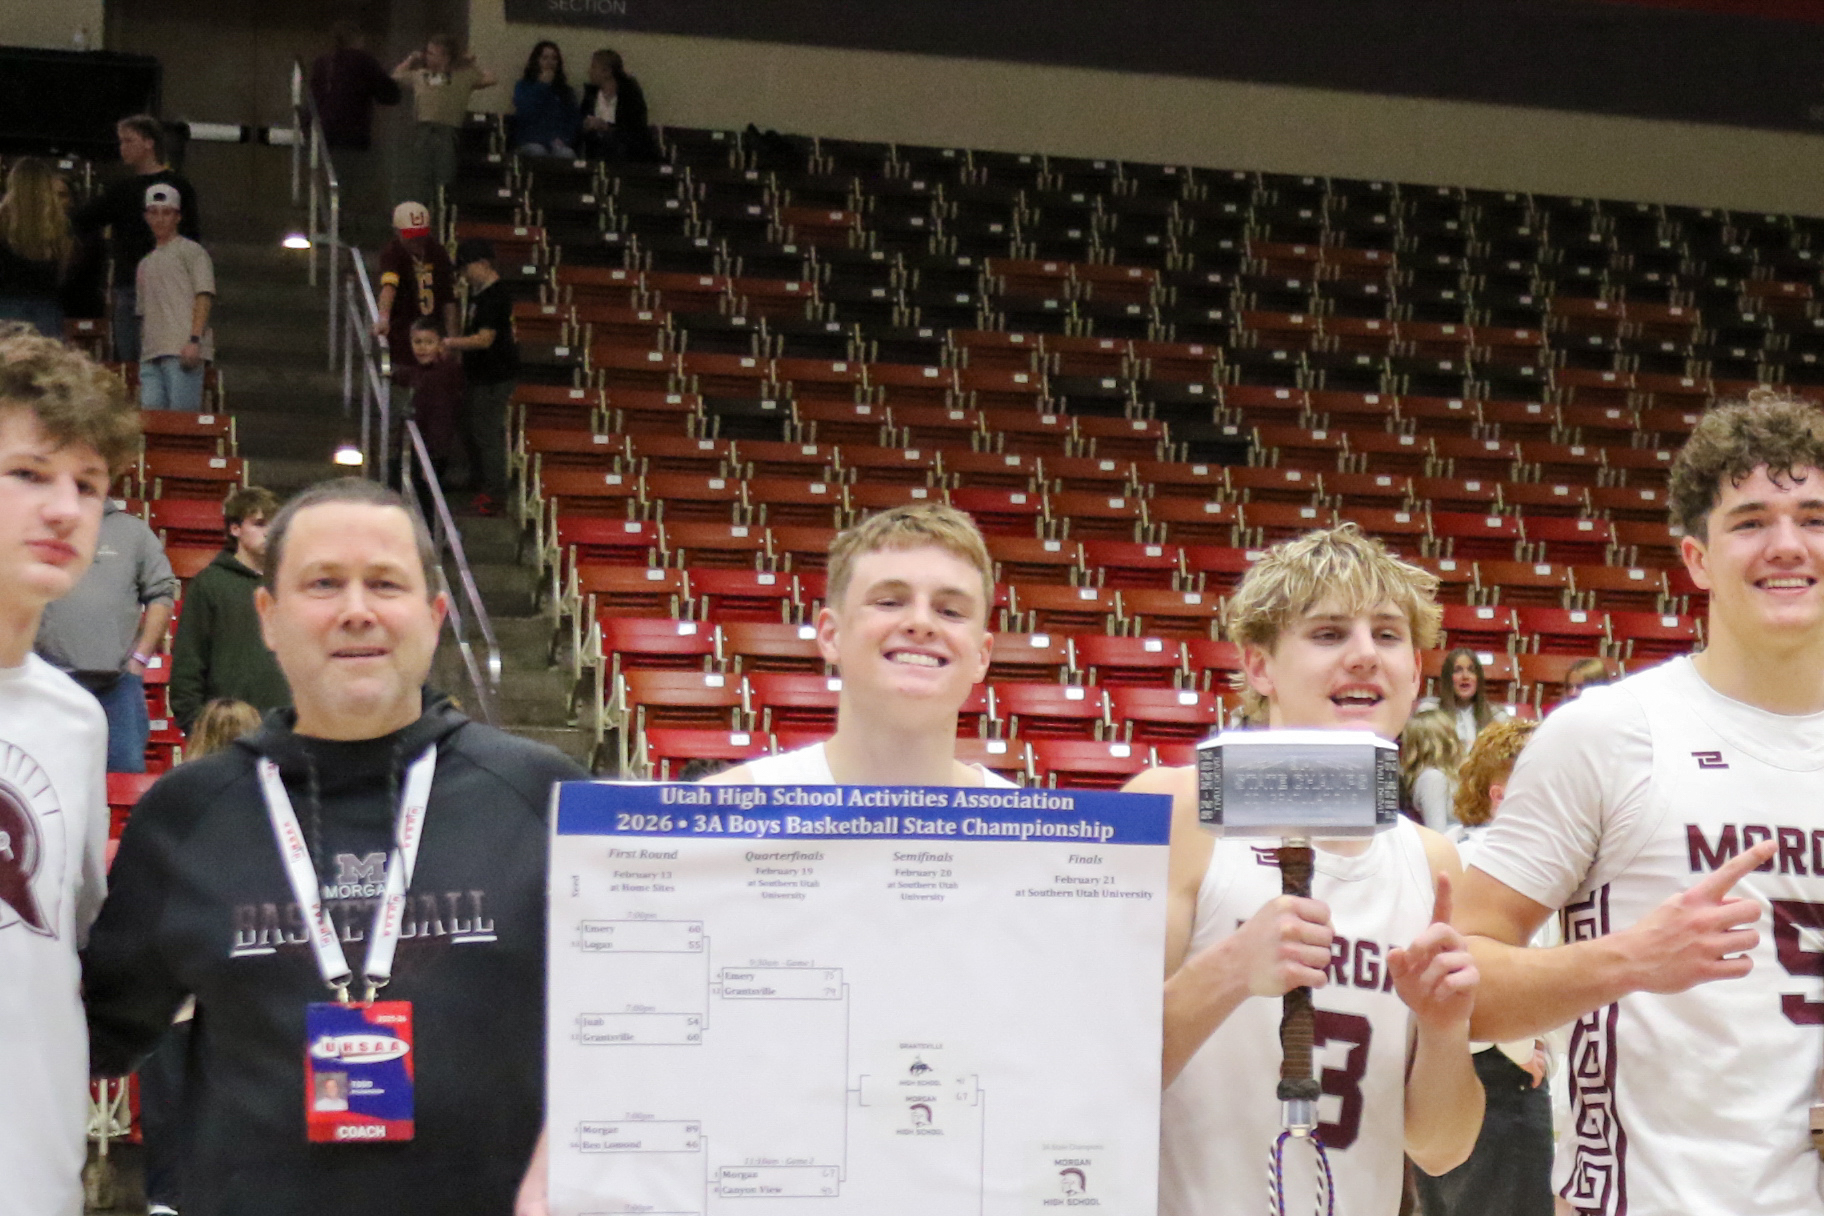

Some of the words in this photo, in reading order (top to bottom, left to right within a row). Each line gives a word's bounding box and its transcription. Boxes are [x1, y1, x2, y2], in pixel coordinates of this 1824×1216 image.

[418, 272, 434, 315] 5
[661, 787, 712, 805] Utah
[717, 788, 767, 809] High
[773, 788, 843, 807] School
[848, 788, 949, 808] Activities
[952, 791, 1075, 811] Association
[617, 813, 674, 832] 2026
[693, 816, 724, 833] 3A
[728, 816, 781, 838] Boys
[786, 816, 899, 835] Basketball
[903, 817, 957, 835] State
[962, 817, 1115, 842] Championship
[608, 848, 637, 859] First
[639, 849, 679, 860] Round
[745, 850, 825, 862] Quarterfinals
[892, 851, 954, 863] Semifinals
[1068, 854, 1103, 865] Finals
[337, 853, 388, 884] M
[755, 867, 798, 877] February
[801, 867, 813, 876] 19
[895, 868, 938, 879] February
[940, 868, 953, 877] 20
[613, 870, 657, 880] February
[1055, 875, 1100, 886] February
[1103, 875, 1116, 884] 21
[653, 883, 675, 892] Sites
[758, 879, 797, 887] Southern
[898, 881, 937, 889] Southern
[323, 883, 390, 901] MORGA
[761, 891, 806, 901] University
[1015, 888, 1026, 897] at
[1028, 888, 1073, 897] Southern
[1076, 889, 1099, 898] Utah
[1102, 889, 1153, 900] University
[901, 893, 945, 903] University
[326, 1041, 401, 1052] UHSAA
[1310, 1010, 1372, 1151] 3
[336, 1124, 387, 1139] COACH
